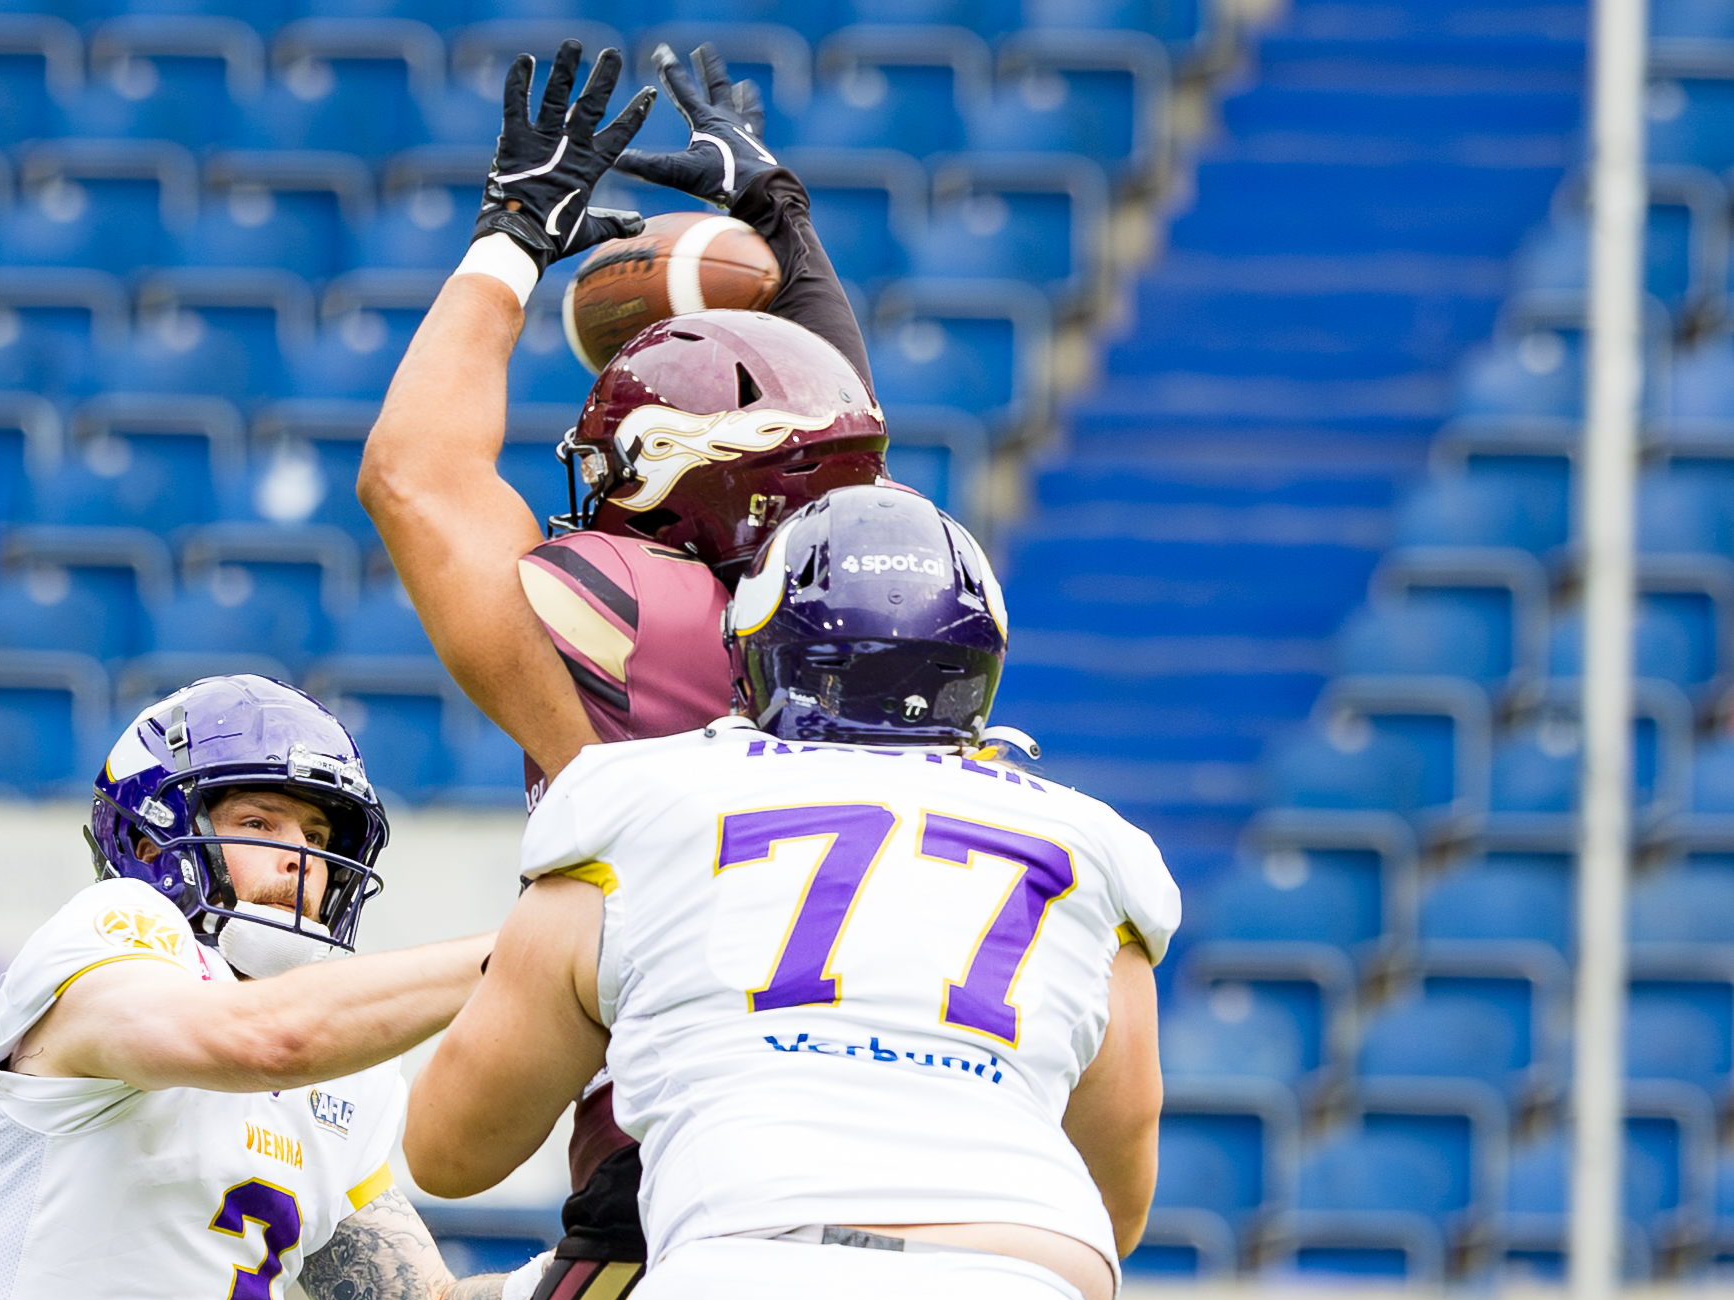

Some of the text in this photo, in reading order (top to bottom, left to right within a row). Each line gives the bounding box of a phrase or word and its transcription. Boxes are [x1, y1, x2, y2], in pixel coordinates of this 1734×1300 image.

[747, 493, 787, 529] 97
[861, 553, 946, 578] spot.ai
[713, 801, 1078, 1049] 77
[763, 1033, 1003, 1084] Verbund
[244, 1120, 303, 1170] VIENNA
